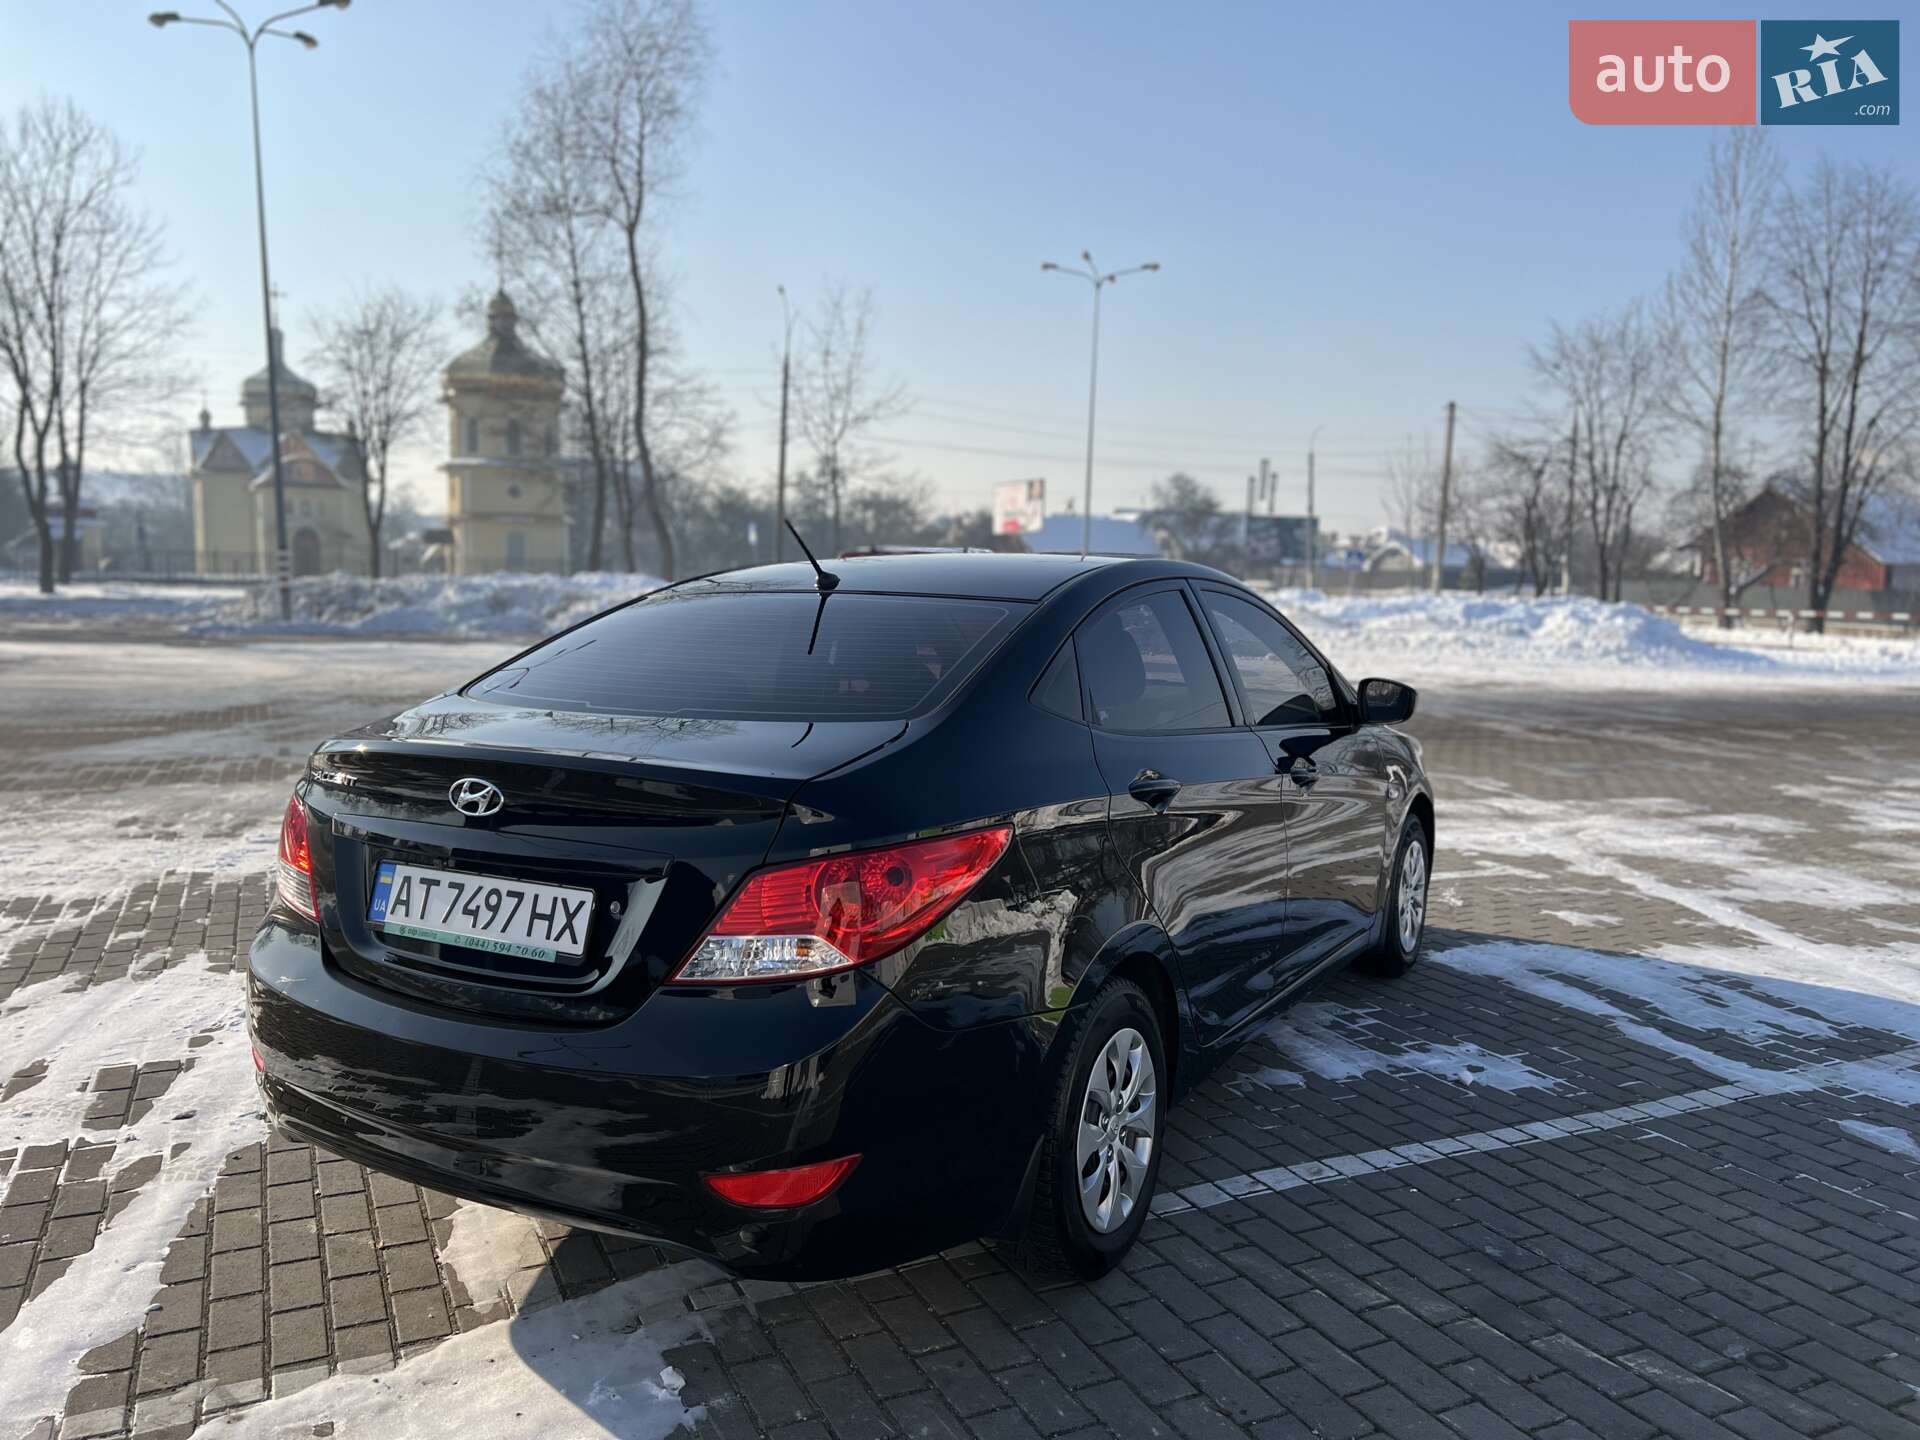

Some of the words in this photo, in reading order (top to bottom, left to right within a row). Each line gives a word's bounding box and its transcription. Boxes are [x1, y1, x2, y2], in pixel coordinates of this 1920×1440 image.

[374, 898, 386, 913] UA
[390, 875, 441, 920] AT
[441, 881, 525, 934] 7497
[526, 893, 586, 945] HX
